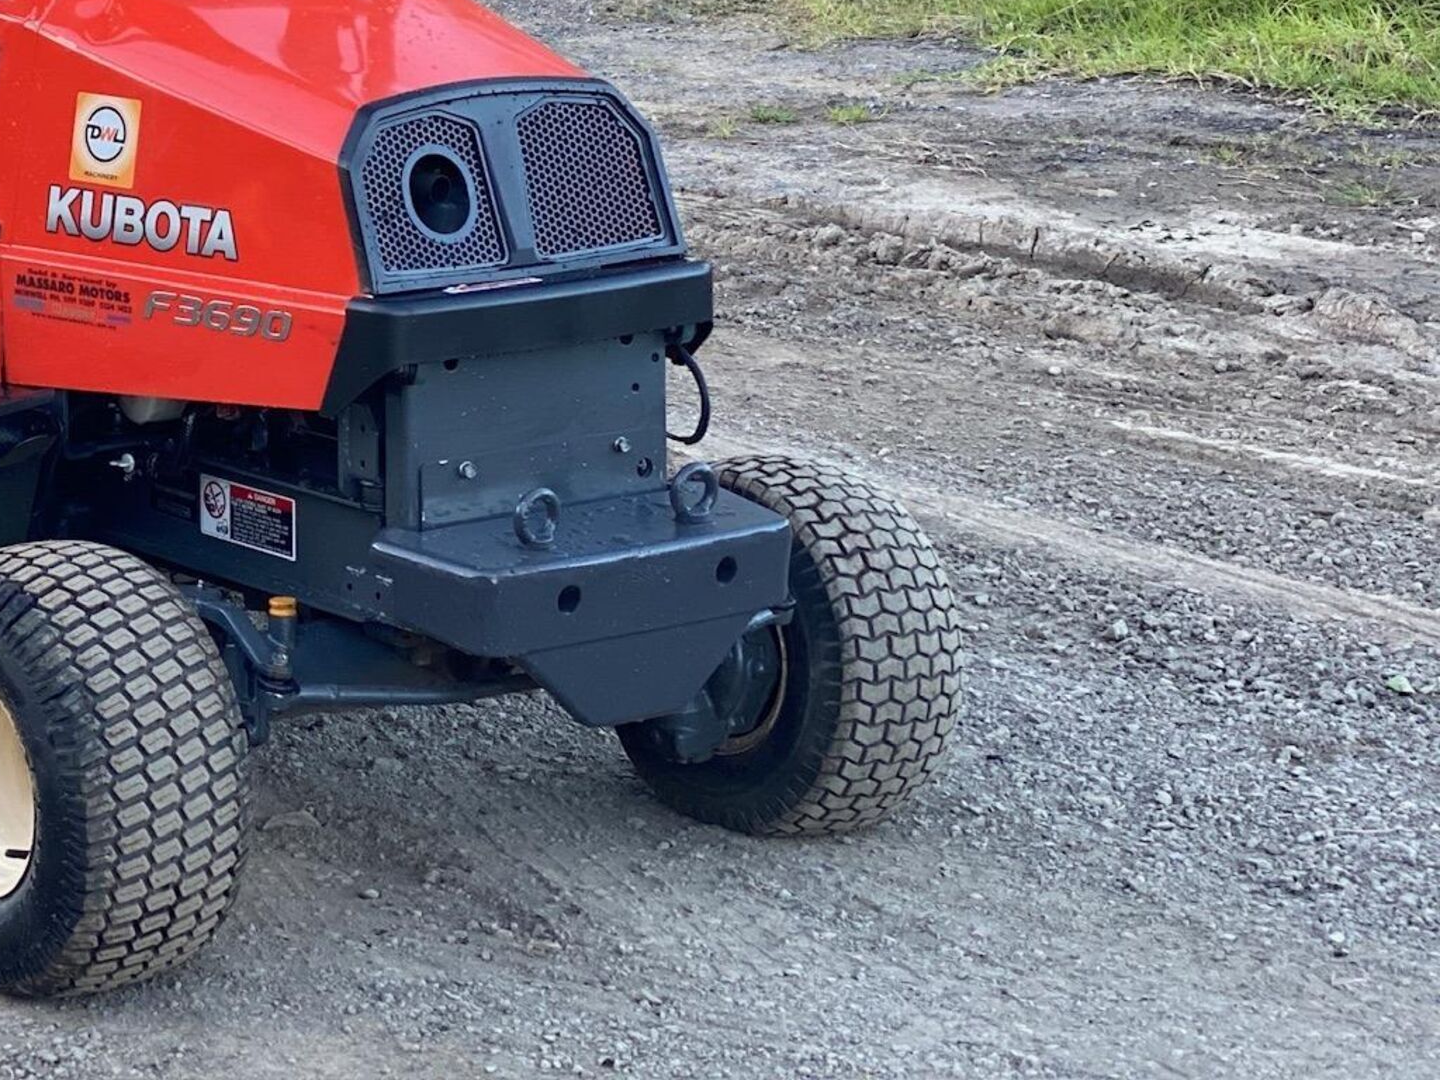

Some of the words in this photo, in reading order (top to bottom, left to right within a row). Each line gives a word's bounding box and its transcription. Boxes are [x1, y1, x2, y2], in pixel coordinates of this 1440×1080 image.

[45, 184, 238, 262] KUBOTA
[16, 274, 75, 294] MASSARO
[78, 284, 131, 303] MOTORS
[143, 290, 293, 342] F3690
